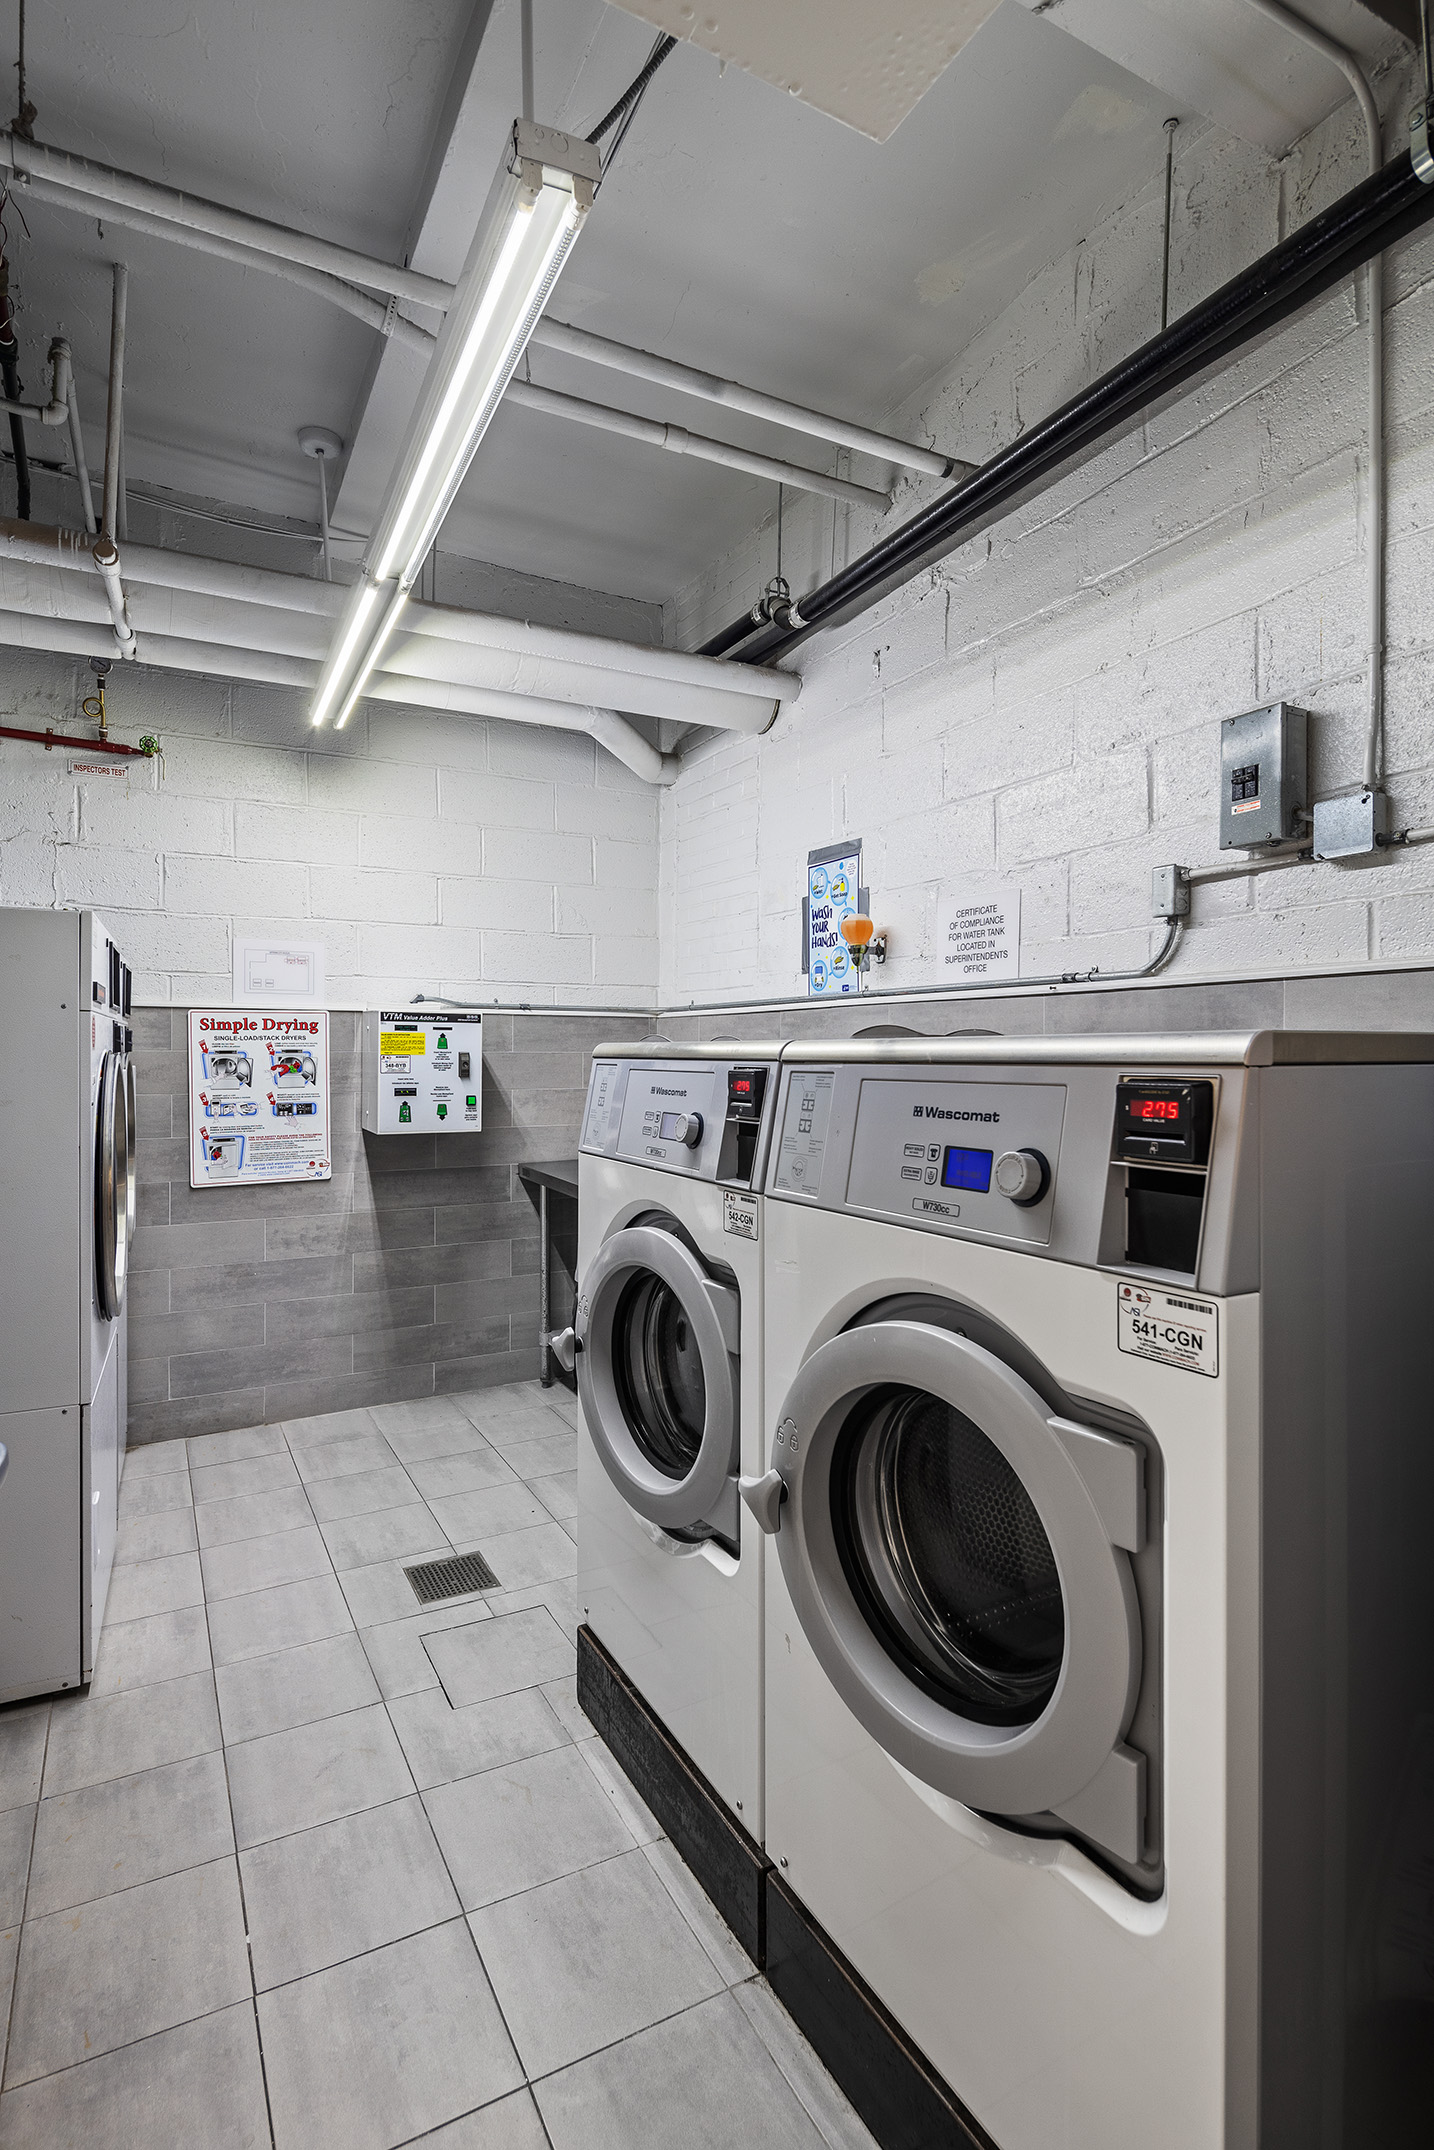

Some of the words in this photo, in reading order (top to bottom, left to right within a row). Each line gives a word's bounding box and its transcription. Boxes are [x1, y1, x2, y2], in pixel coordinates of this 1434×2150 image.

[74, 764, 110, 774] INSPECTORS
[956, 904, 997, 918] CERTIFICATE
[949, 922, 958, 930] OF
[960, 915, 1004, 929] COMPLIANCE
[948, 933, 962, 941] FOR
[963, 929, 986, 940] WATER
[987, 927, 1005, 936] TANK
[957, 941, 987, 951] LOCATED
[988, 940, 995, 948] IN
[945, 950, 1008, 964] SUPERINTENDENTS
[963, 964, 987, 973] OFFICE
[199, 1017, 258, 1034] Simple
[262, 1018, 319, 1034] Drying
[656, 1087, 687, 1097] Wascomat
[925, 1106, 1000, 1123] Wascomat
[923, 1201, 950, 1214] W730cc
[729, 1211, 753, 1225] 542-CGN
[1132, 1319, 1203, 1351] 541-CGN
